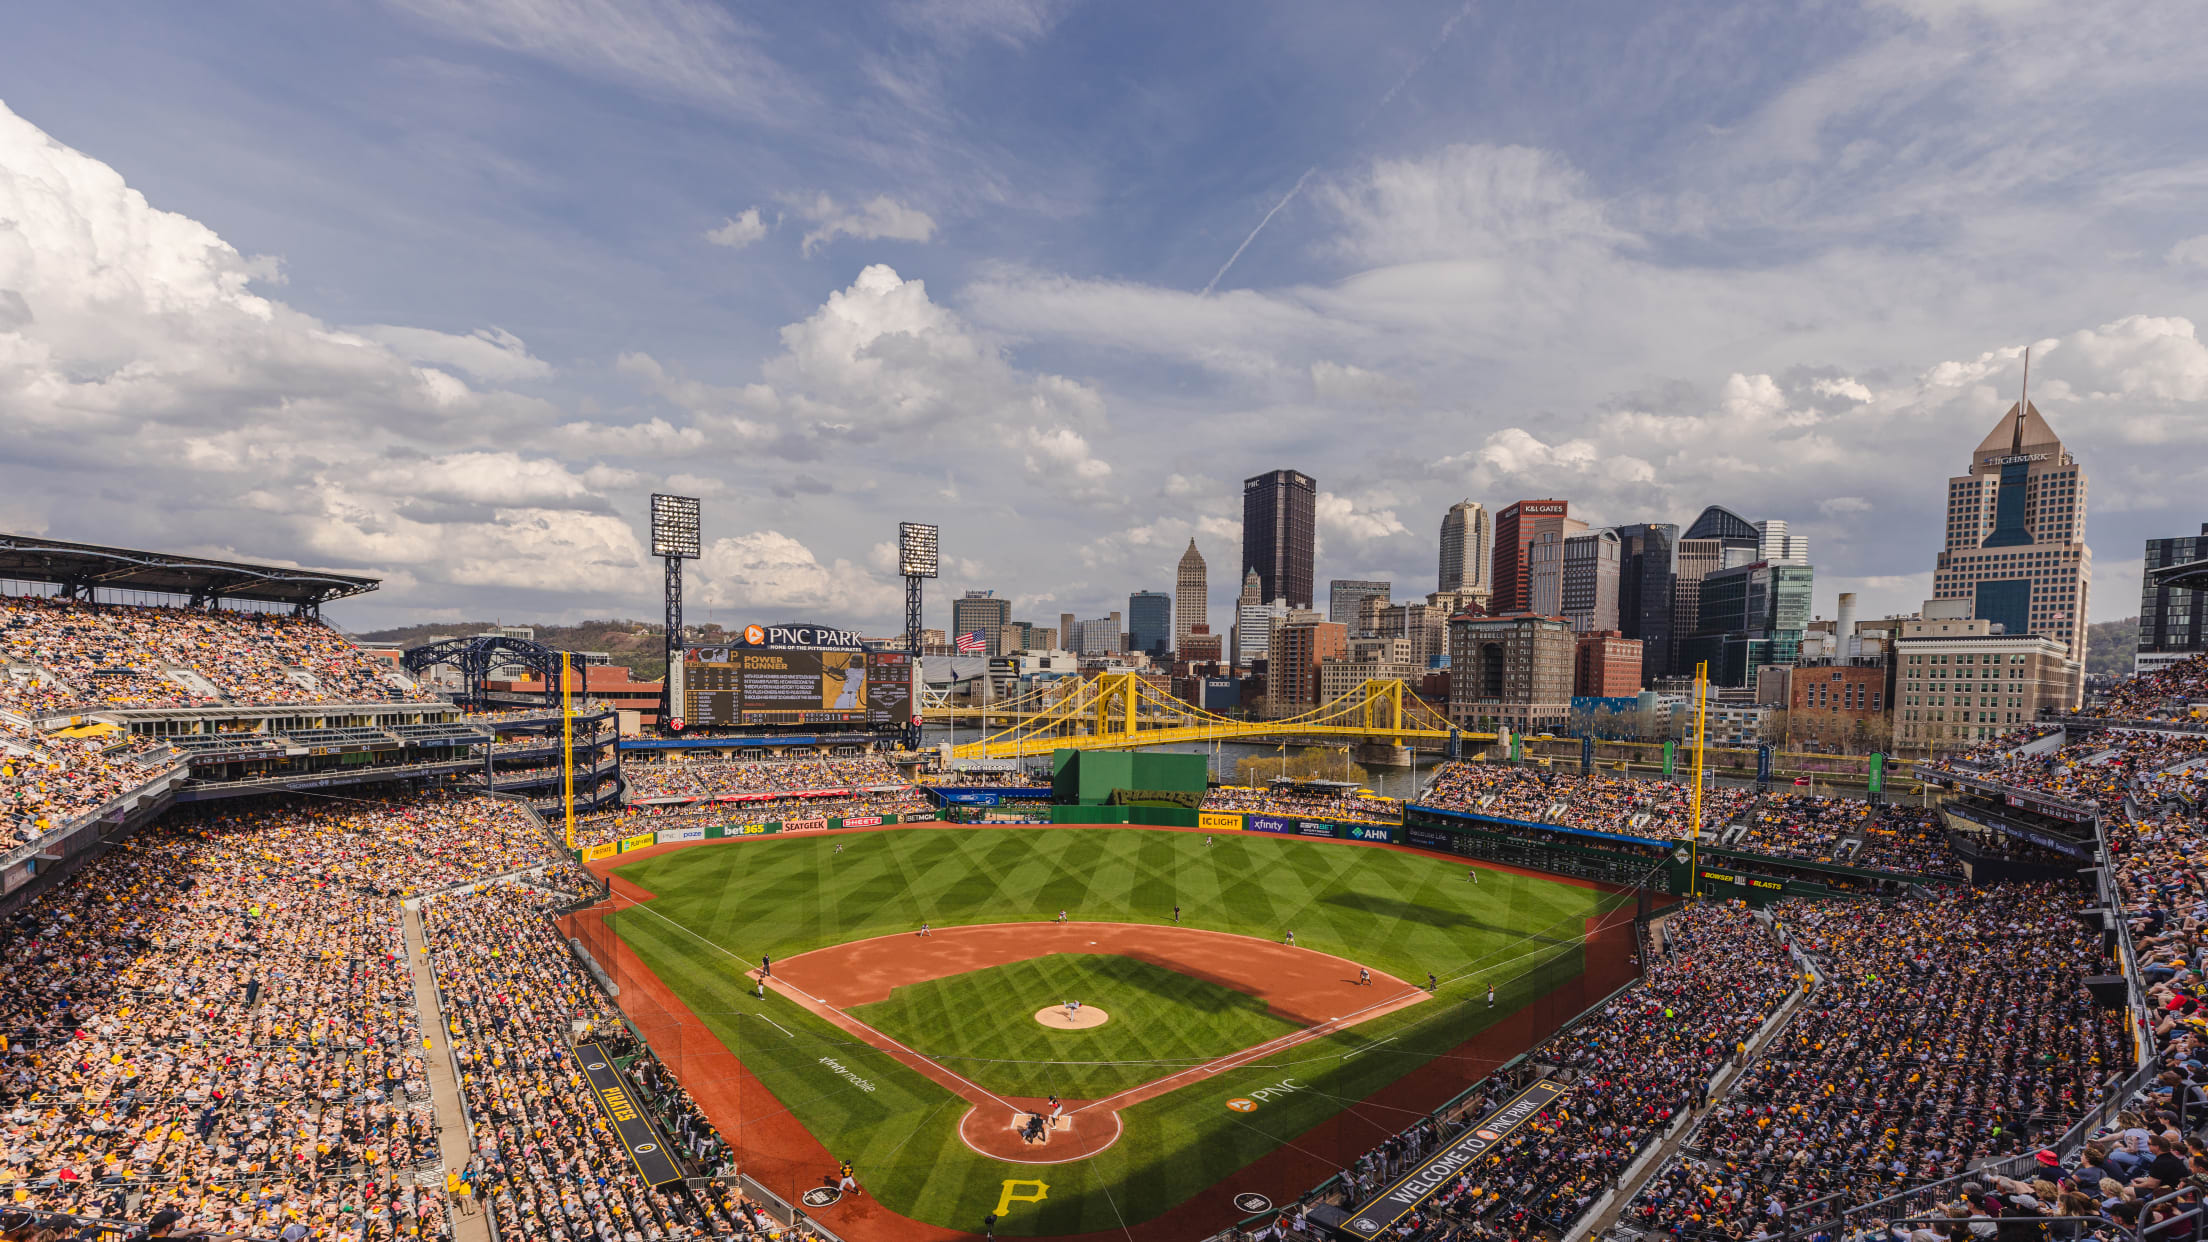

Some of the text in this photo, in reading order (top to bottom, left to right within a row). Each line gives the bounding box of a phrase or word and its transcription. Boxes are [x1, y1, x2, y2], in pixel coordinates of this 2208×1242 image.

[1989, 453, 2048, 466] HIGHMARK
[1540, 505, 1563, 513] GATES
[768, 628, 863, 647] PNC PARK
[743, 655, 783, 663] POWER
[845, 817, 880, 826] SHEETZ
[907, 813, 935, 822] BETMGM
[1213, 817, 1238, 828] LIGHT
[724, 824, 765, 835] bet365
[785, 821, 824, 832] SEATGEEK
[1254, 819, 1283, 832] xfinity
[1319, 823, 1334, 831] BET
[683, 831, 702, 839] paze
[1364, 829, 1387, 841] AHN
[1704, 872, 1734, 882] BOWSER
[1753, 880, 1782, 890] BLASTS
[1250, 1078, 1308, 1103] PNC
[601, 1086, 638, 1122] PIRATES
[1389, 1098, 1540, 1204] WELCOME TO PNC PARK
[993, 1179, 1051, 1217] P
